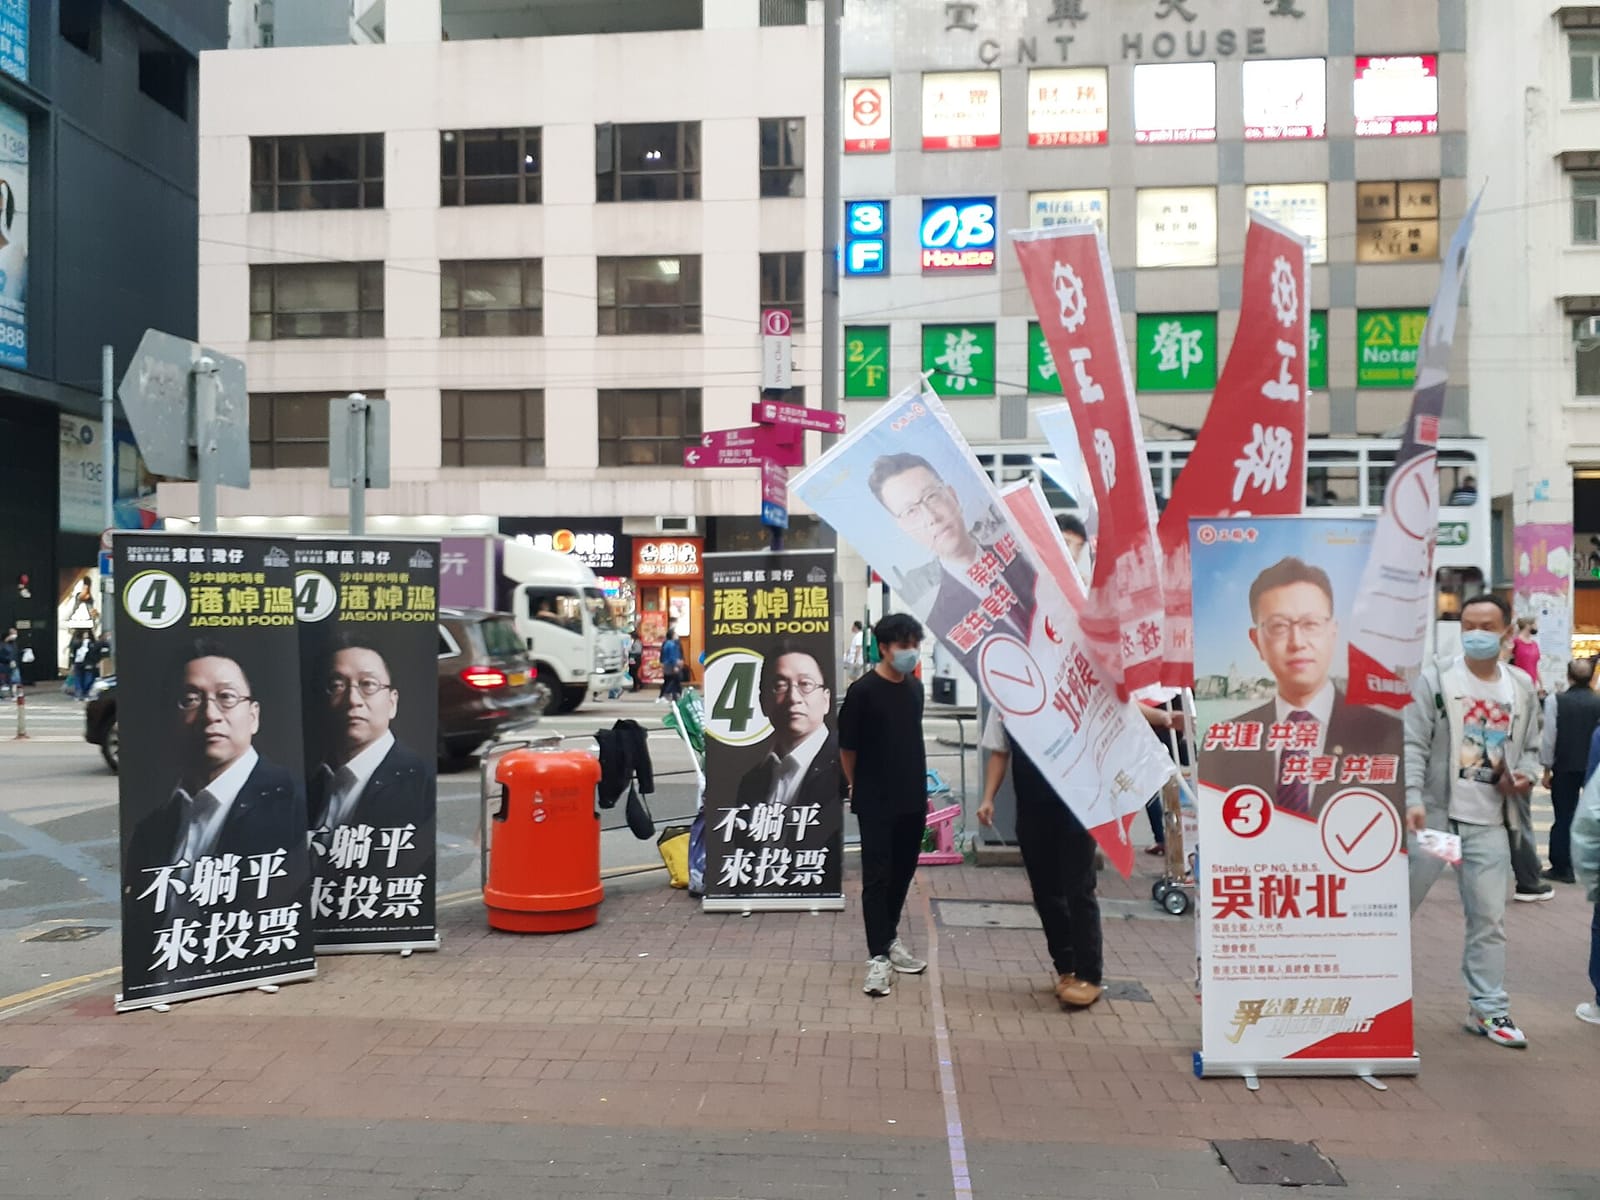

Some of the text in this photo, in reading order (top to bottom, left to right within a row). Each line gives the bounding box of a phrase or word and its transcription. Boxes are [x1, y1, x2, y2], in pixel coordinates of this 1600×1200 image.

[978, 28, 1267, 66] CNT HOUSE
[852, 205, 883, 232] 3
[922, 203, 995, 249] OB
[852, 243, 883, 270] F
[923, 250, 995, 267] House
[848, 339, 885, 388] 2/F
[935, 328, 983, 391] 葉
[1150, 320, 1204, 379] 鄧
[1362, 346, 1418, 364] Notar
[138, 579, 168, 620] 4
[190, 586, 294, 614] 潘焯鴻
[296, 578, 321, 615] 4
[340, 585, 436, 611] 潘焯鴻
[713, 586, 829, 621] 潘焯鴻
[189, 615, 295, 627] JASON POON
[338, 611, 436, 622] JASON POON
[712, 621, 830, 635] JASON POON
[711, 661, 757, 732] 4
[1204, 721, 1321, 750] 共建 共榮
[1282, 754, 1398, 784] 共享 共贏
[712, 802, 822, 843] 不躺平
[1230, 793, 1264, 835] 3
[137, 847, 288, 913] 不躺平
[717, 847, 830, 888] 來投票
[1211, 864, 1251, 875] Stanley,
[1254, 864, 1268, 873] CP
[1292, 863, 1321, 873] S.B.S.
[1211, 874, 1348, 919] 吳秋北
[147, 902, 303, 972] 來投票
